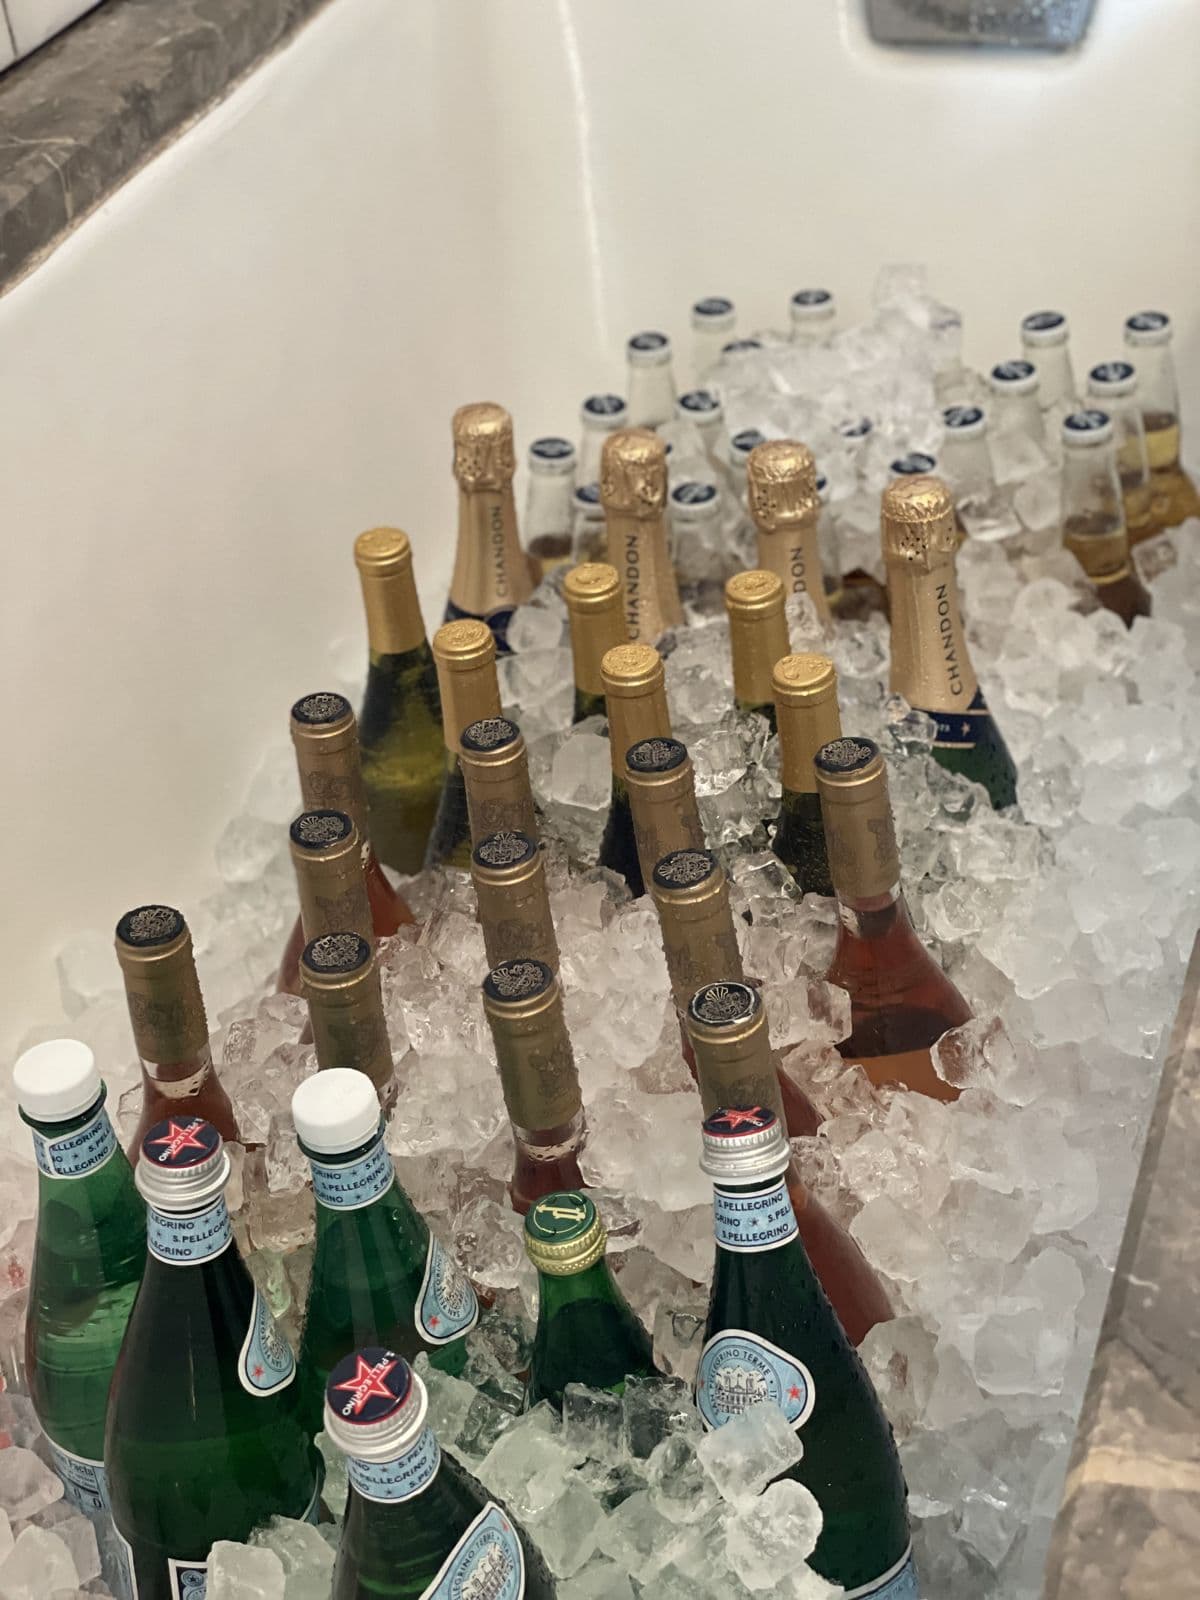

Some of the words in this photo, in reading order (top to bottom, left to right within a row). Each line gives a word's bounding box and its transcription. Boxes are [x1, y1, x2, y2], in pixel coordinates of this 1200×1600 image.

[489, 506, 507, 597] CHANDON
[625, 534, 640, 640] CHANDON
[936, 584, 964, 696] CHANDON
[743, 1350, 772, 1376] TERME
